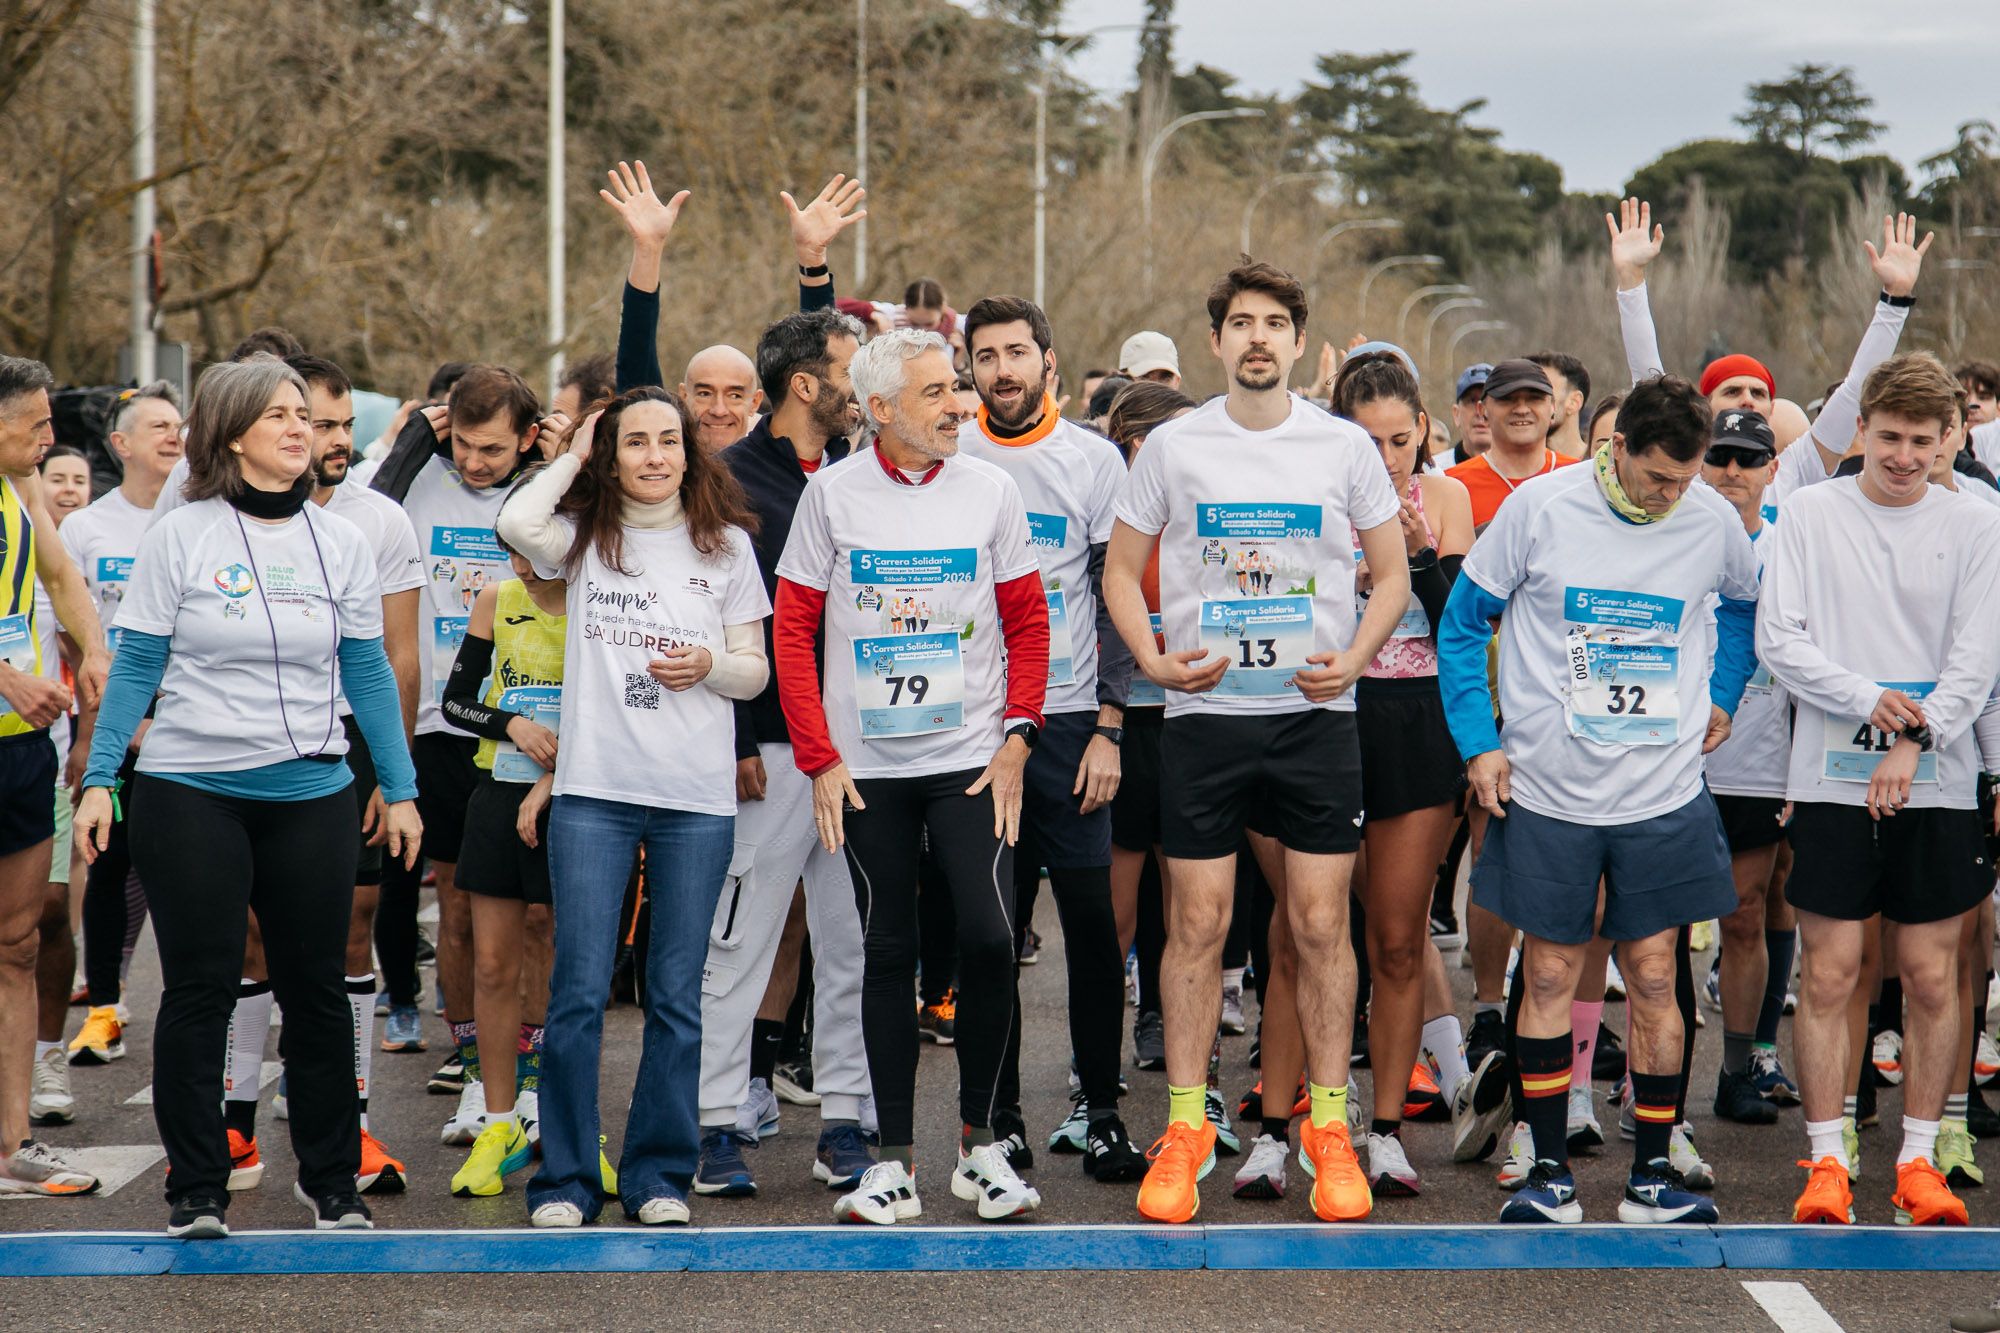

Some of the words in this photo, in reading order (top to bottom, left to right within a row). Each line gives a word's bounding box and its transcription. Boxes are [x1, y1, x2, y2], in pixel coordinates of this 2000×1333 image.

[1220, 510, 1254, 518] Carrera
[1257, 510, 1296, 519] Solidaria
[454, 534, 480, 542] Carrera
[1286, 528, 1315, 538] 2026
[1033, 537, 1060, 548] 2026
[912, 556, 952, 565] Solidaria
[266, 565, 294, 574] SALUD
[943, 573, 972, 583] 2026
[587, 582, 650, 613] Siempre
[1591, 597, 1624, 606] Carrera
[1627, 600, 1664, 612] Solidaria
[1225, 608, 1256, 616] Carrera
[1259, 605, 1295, 614] Solidaria
[628, 616, 657, 630] hacer
[683, 629, 700, 640] por
[1652, 620, 1676, 633] 2026
[873, 645, 904, 653] Carrera
[907, 642, 943, 651] Solidaria
[1239, 639, 1276, 668] 13
[1600, 652, 1629, 660] Carrera
[1572, 646, 1588, 680] 0035
[886, 675, 929, 706] 79
[519, 694, 547, 703] Carrera
[1607, 685, 1646, 714] 32
[1853, 722, 1899, 752] 41
